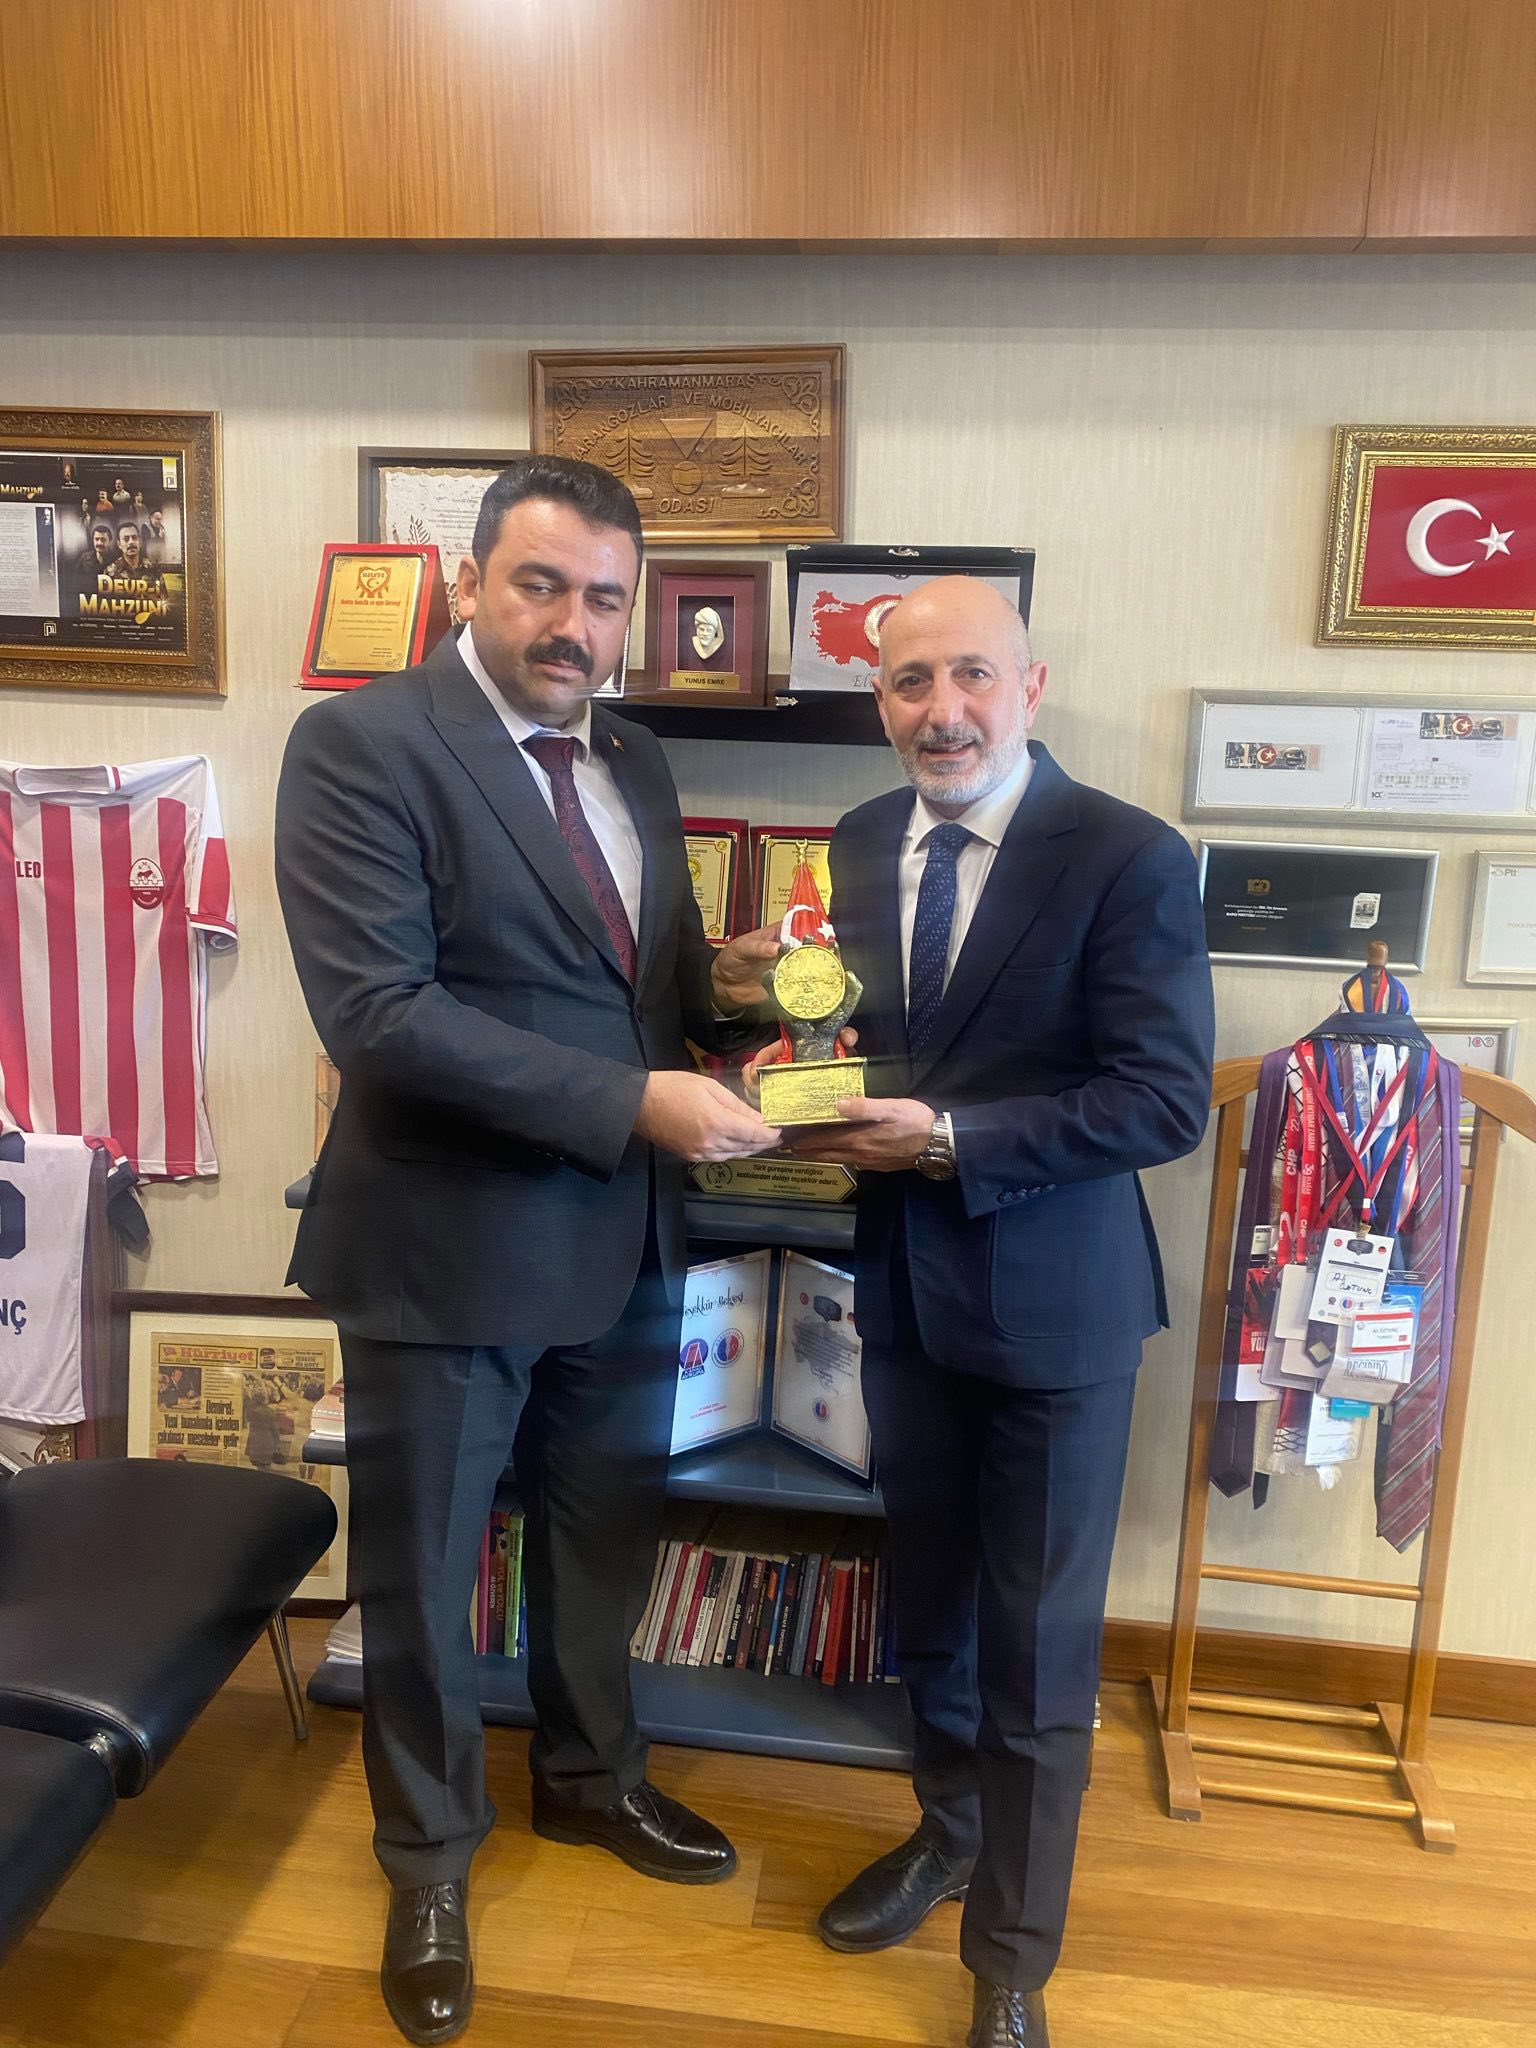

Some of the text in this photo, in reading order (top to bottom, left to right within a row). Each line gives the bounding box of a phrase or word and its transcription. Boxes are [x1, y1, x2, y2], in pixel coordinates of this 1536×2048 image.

[614, 375, 756, 390] KAHRAMANMARAŞ
[570, 395, 667, 461] ARANGOZLAR
[683, 392, 702, 405] VE
[658, 497, 714, 514] ODASI
[684, 677, 725, 686] YUNUS EMRE
[1504, 868, 1517, 877] Ptt
[1286, 1149, 1297, 1176] CHP
[180, 1346, 254, 1361] Hürriyet
[164, 1414, 178, 1428] Yeni
